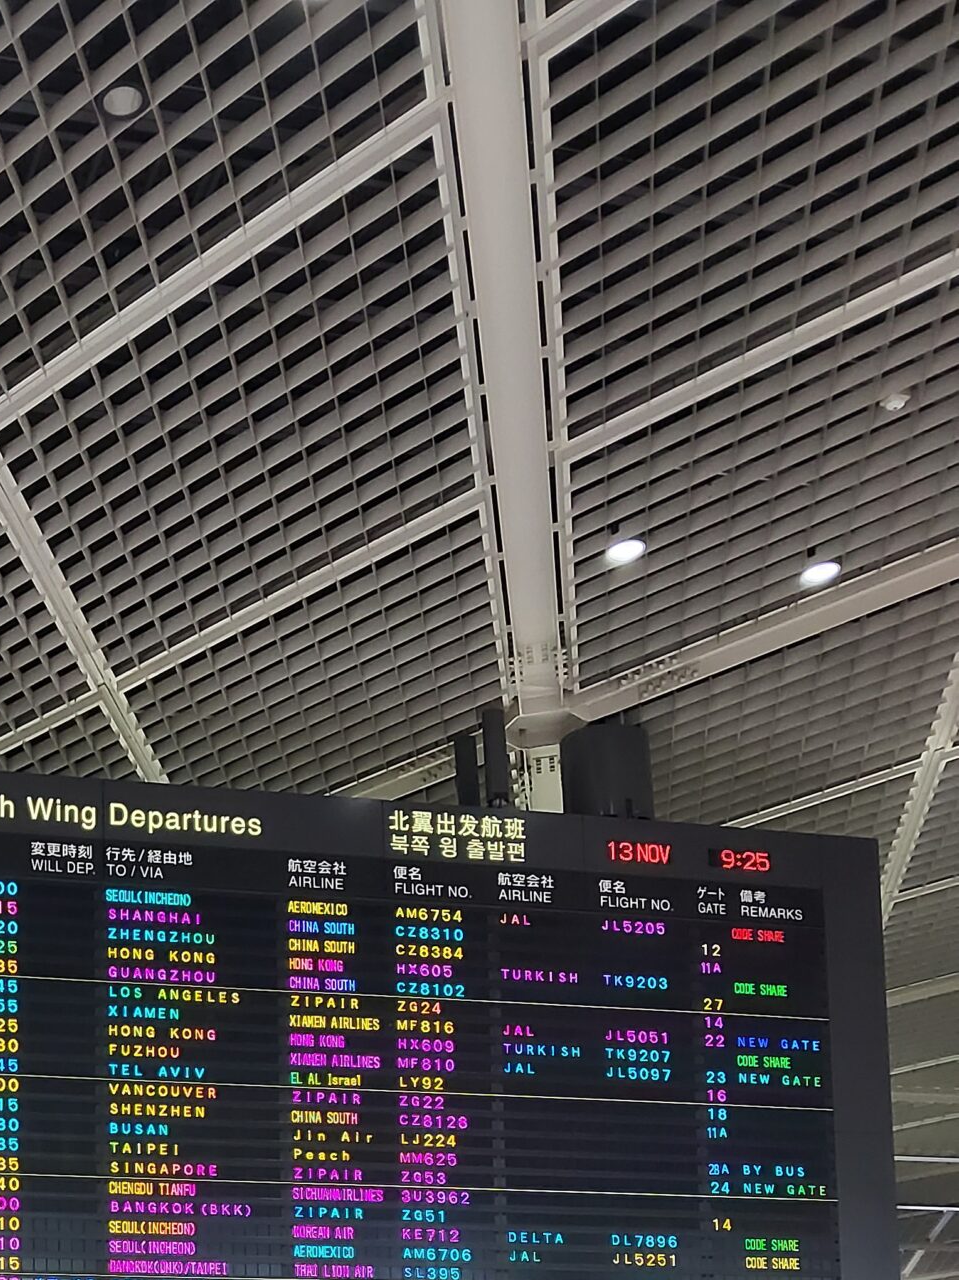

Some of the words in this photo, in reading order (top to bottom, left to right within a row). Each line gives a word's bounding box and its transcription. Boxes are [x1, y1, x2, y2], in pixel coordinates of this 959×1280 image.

[27, 797, 95, 830] Wing
[110, 803, 261, 835] Departures
[390, 834, 430, 855] 북쪽
[439, 837, 457, 857] 윙
[466, 839, 525, 861] 출발편
[31, 859, 62, 872] WILL
[68, 861, 95, 874] DEP.
[288, 859, 346, 875] 航空会社
[721, 850, 770, 871] 9:25
[106, 864, 126, 876] TO
[140, 866, 163, 878] VIA
[394, 866, 421, 880] 便名
[289, 876, 343, 890] AIRLINE
[498, 873, 554, 888] 航空会社
[599, 880, 625, 893] 便名
[395, 883, 443, 896] FLIGHT
[499, 889, 551, 902] AIRLINE
[740, 890, 766, 903] 備考
[601, 896, 647, 908] FLIGHT
[698, 902, 726, 914] GATE
[109, 908, 200, 924] SHANGHAI
[396, 907, 462, 922] AM6754
[500, 914, 530, 925] JAL
[741, 905, 802, 920] REMARKS
[289, 920, 319, 933] CHINA
[324, 922, 354, 934] SOUTH
[396, 926, 463, 941] CZ8310
[602, 920, 664, 934] JL5205
[108, 928, 214, 944] ZHENGZHOU
[108, 947, 154, 960] HONG
[170, 951, 214, 963] KONG
[109, 966, 215, 983] GUANGZHOU
[501, 969, 577, 983] TURKISH
[603, 975, 667, 989] TK9203
[110, 986, 142, 998] LOS
[158, 989, 239, 1003] ANGELES
[291, 996, 358, 1009] ZIPAIR
[704, 998, 723, 1010] 27
[108, 1005, 178, 1020] XIAMEN
[397, 1020, 454, 1034] MF816
[738, 1037, 768, 1048] NEW
[781, 1039, 819, 1051] GATE
[605, 1048, 670, 1062] TK9207
[109, 1064, 142, 1076] TEL
[159, 1066, 204, 1078] AVIV
[707, 1071, 726, 1083] 23
[109, 1083, 216, 1098] VANCOUVER
[110, 1103, 204, 1117] SHENZHEN
[110, 1122, 167, 1135] BUSAN
[402, 1134, 456, 1147] LJ224
[110, 1142, 178, 1155] TAIPEI
[294, 1148, 349, 1161] Peach
[111, 1162, 217, 1176] SINGAPORE
[743, 1165, 761, 1175] BY
[776, 1166, 804, 1177] BUS
[711, 1182, 729, 1194] 24
[509, 1232, 563, 1243] DELTA
[612, 1235, 677, 1248] DL7896
[404, 1248, 471, 1261] AM6706
